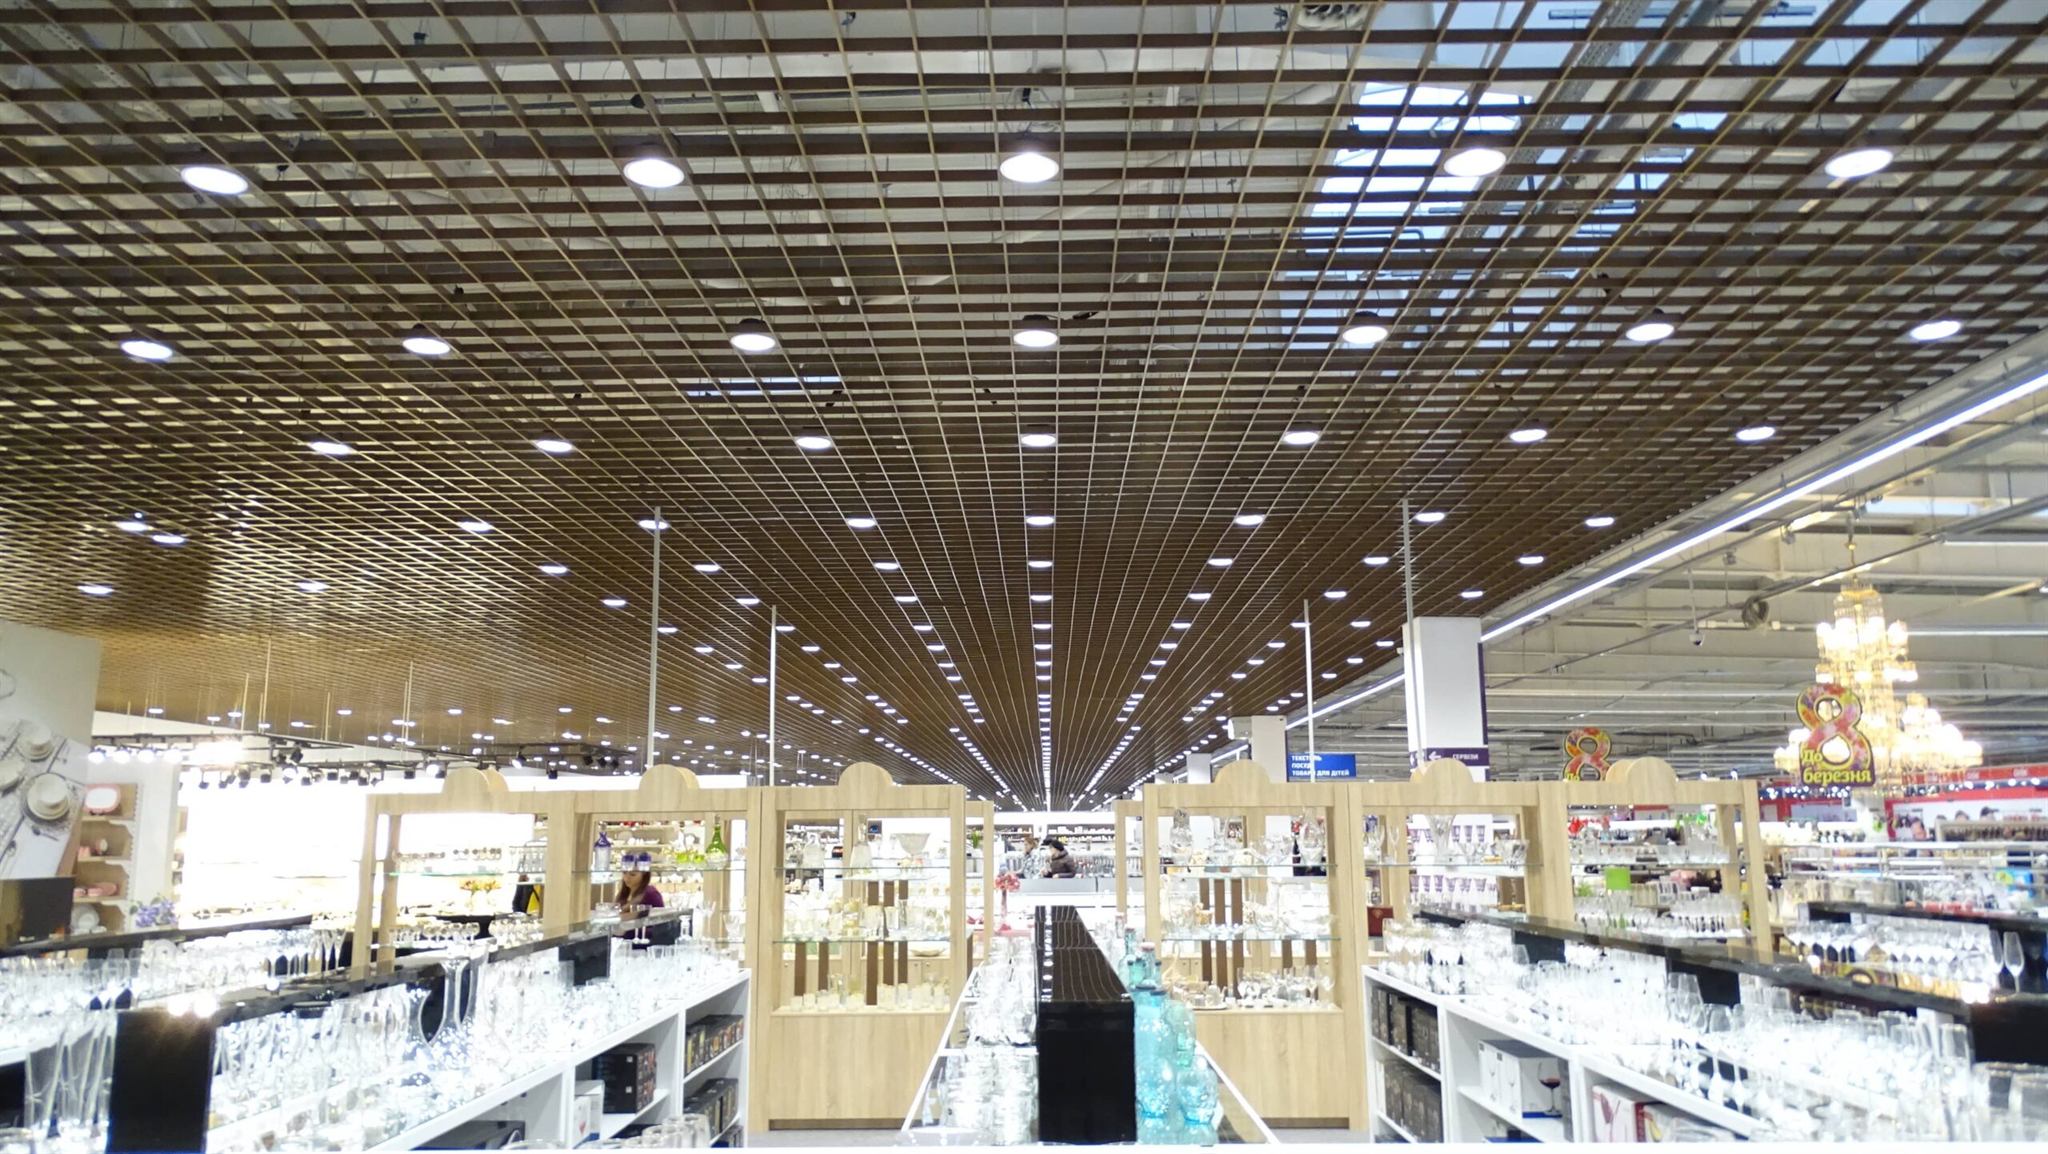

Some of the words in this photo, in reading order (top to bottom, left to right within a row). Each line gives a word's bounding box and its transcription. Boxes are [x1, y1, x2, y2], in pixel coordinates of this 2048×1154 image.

[1797, 684, 1871, 772] 8
[1802, 749, 1823, 763] До
[1803, 768, 1872, 786] березня
